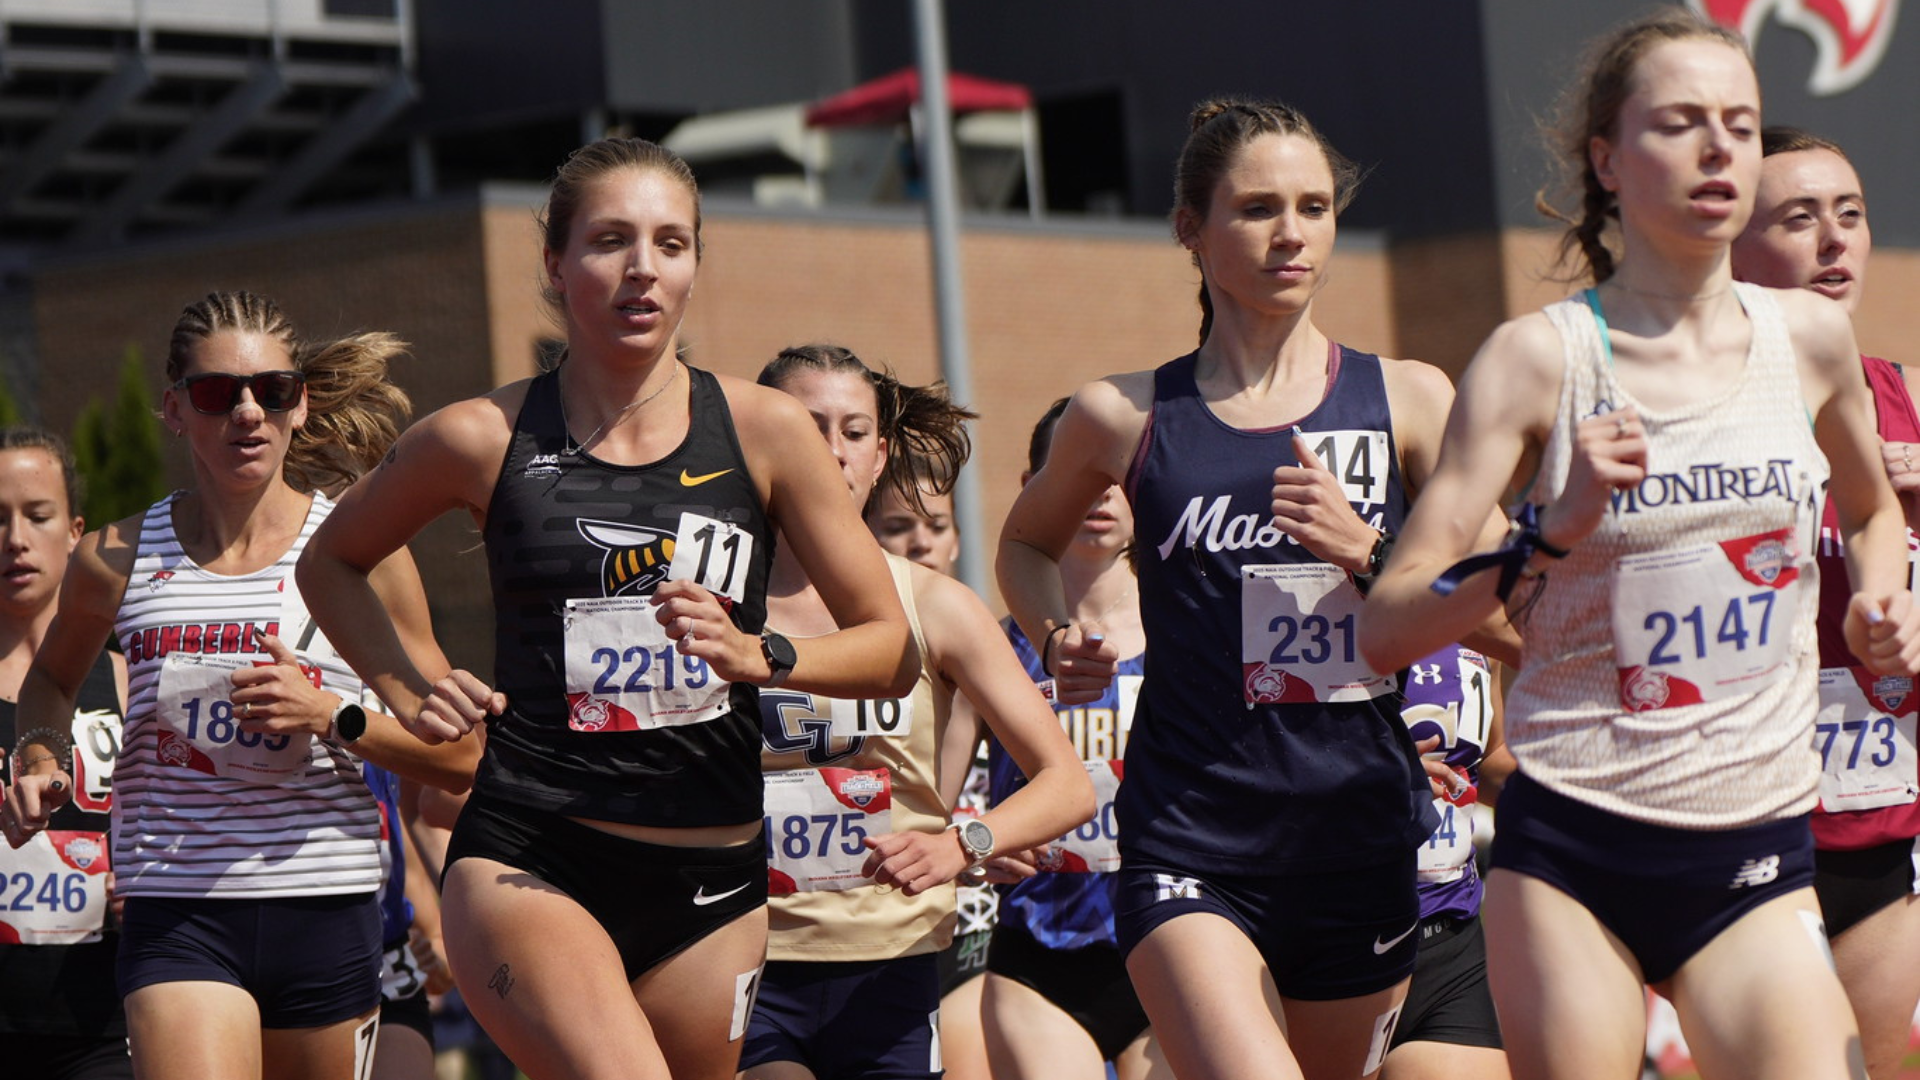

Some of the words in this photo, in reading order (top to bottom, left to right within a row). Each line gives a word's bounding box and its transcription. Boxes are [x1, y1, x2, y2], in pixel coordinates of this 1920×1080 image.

[1315, 435, 1376, 499] 14
[693, 523, 741, 593] 11
[1643, 589, 1777, 667] 2147
[591, 644, 709, 694] 2219
[1815, 716, 1897, 771] 773
[764, 812, 868, 860] 1875
